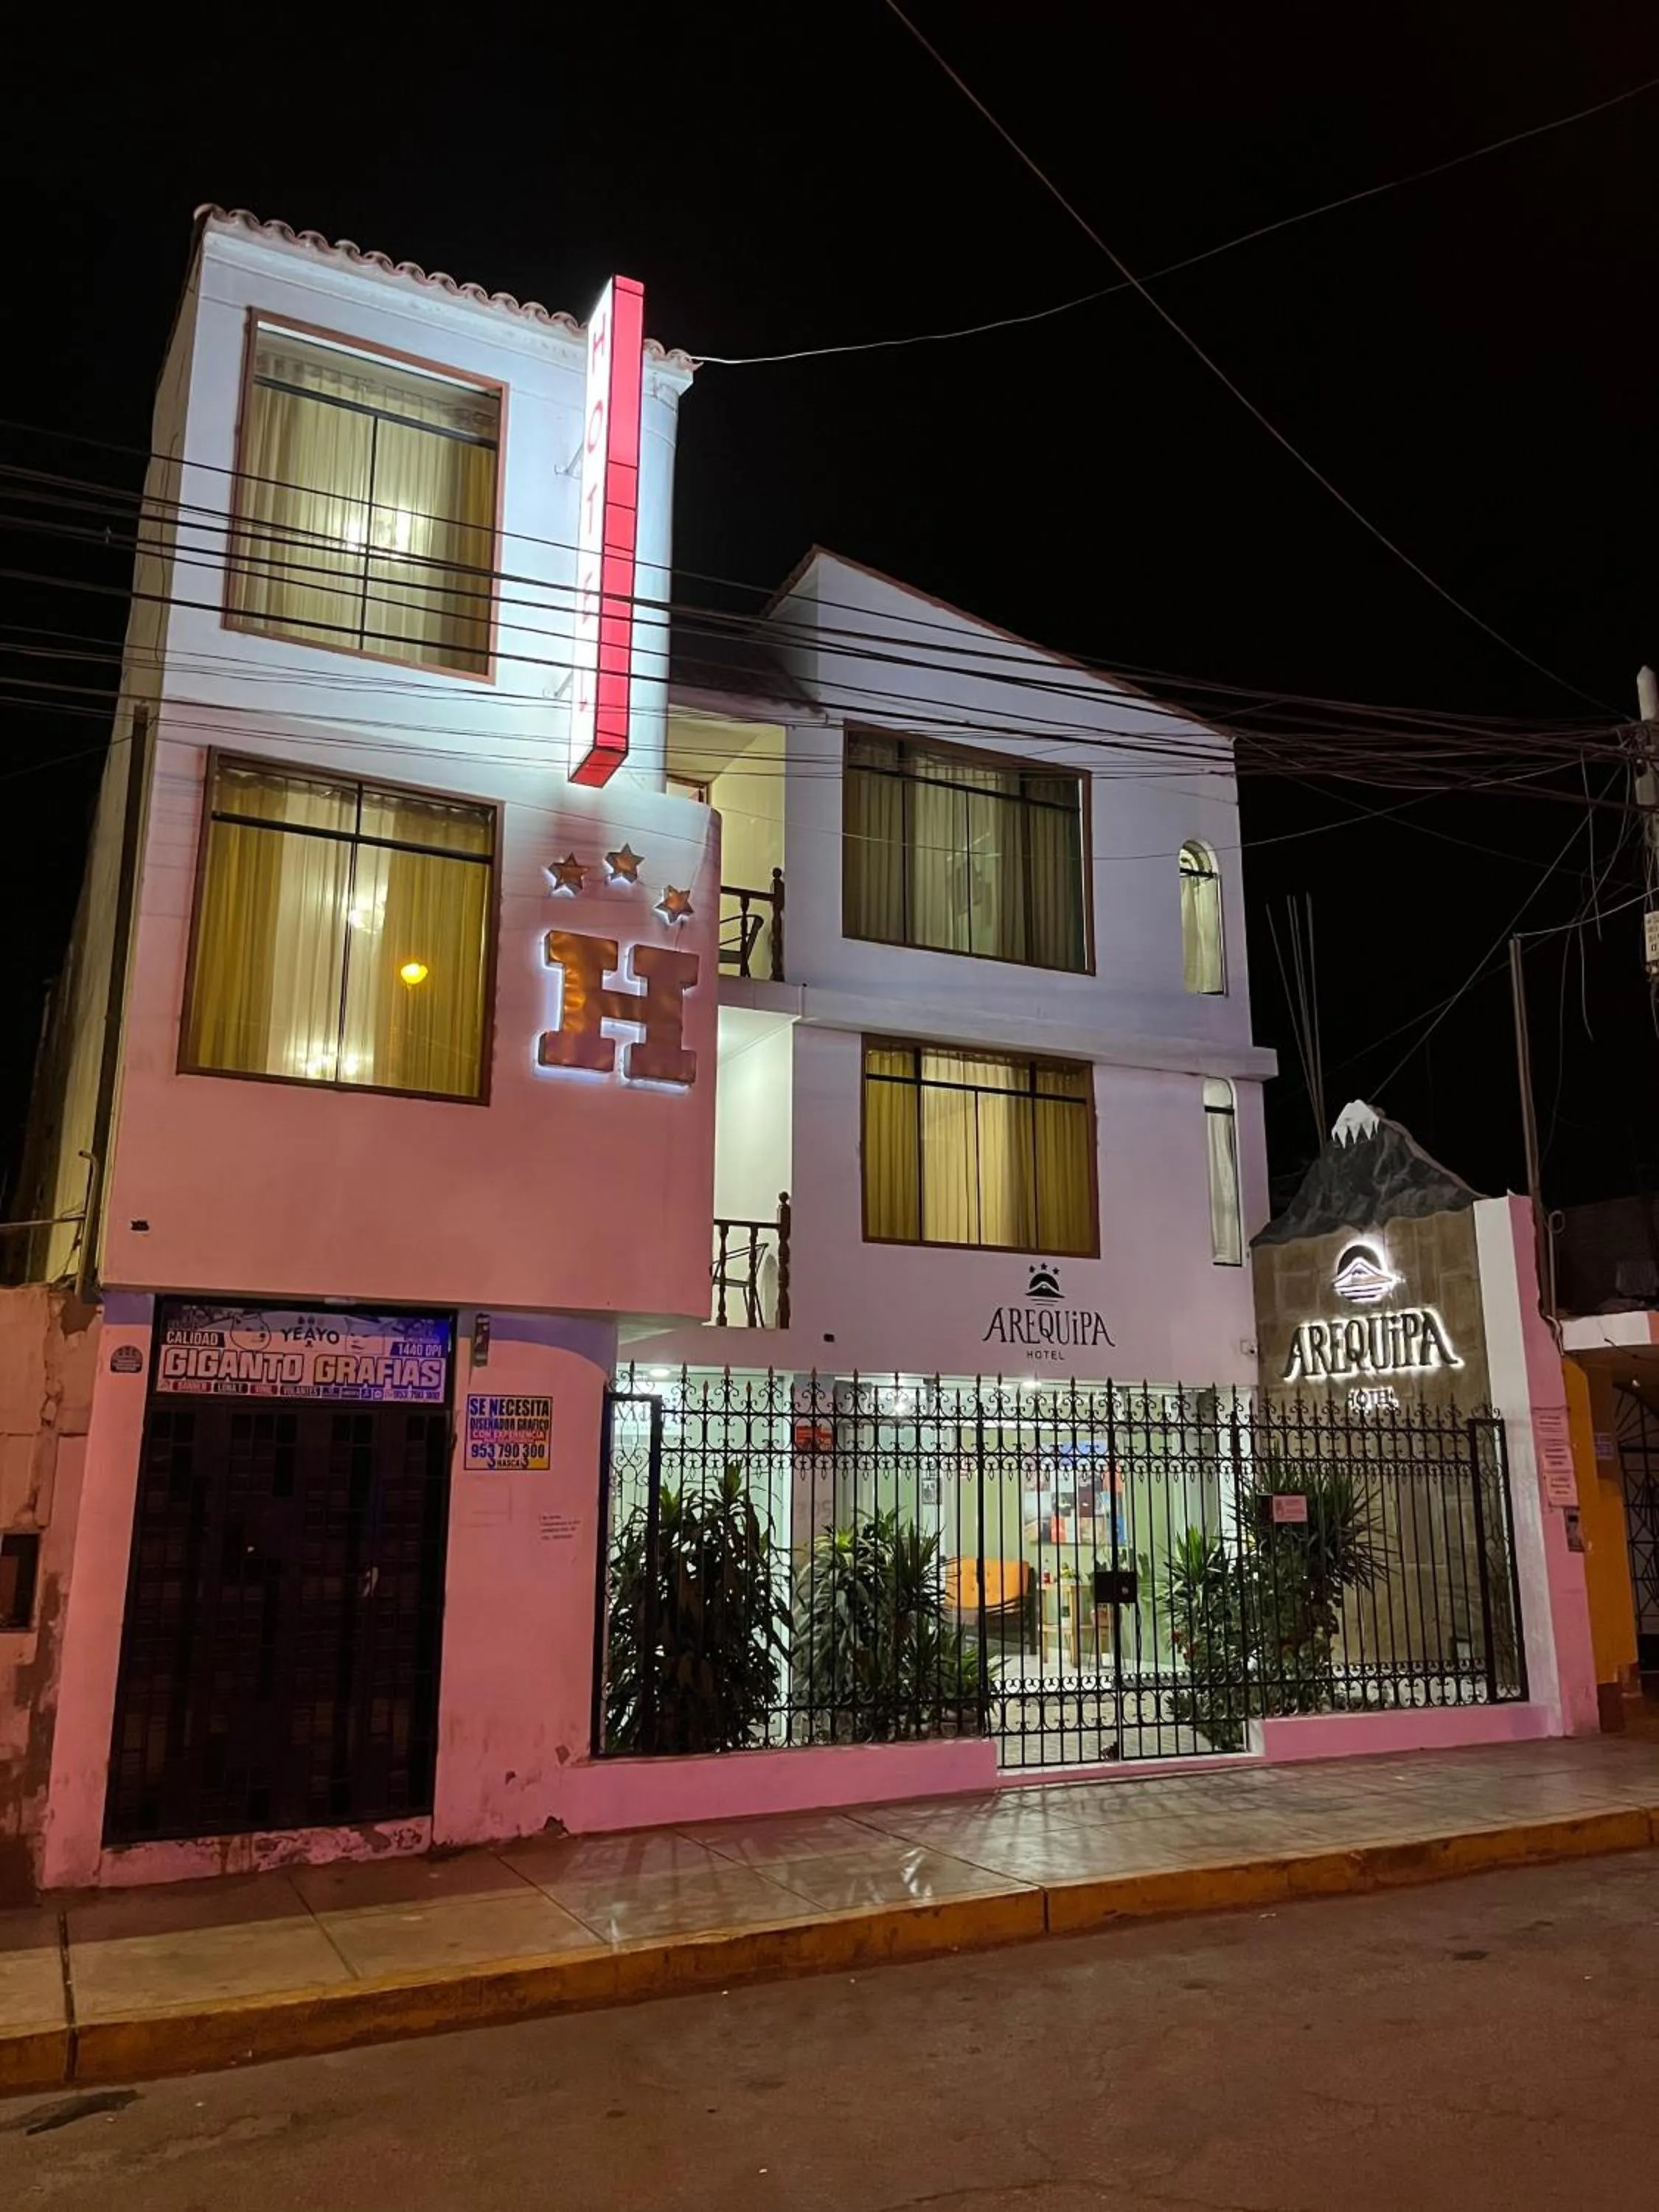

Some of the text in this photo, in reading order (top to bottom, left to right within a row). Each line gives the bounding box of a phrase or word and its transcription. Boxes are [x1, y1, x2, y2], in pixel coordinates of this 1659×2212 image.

[539, 929, 700, 1084] H
[166, 1331, 219, 1346] CALIDAD
[398, 1343, 422, 1356] 1440
[1026, 1350, 1064, 1360] HOTEL
[163, 1346, 304, 1383] GIGANTO
[314, 1354, 442, 1389] GRAFIAS
[470, 1397, 549, 1416] SE NECESITA
[471, 1443, 546, 1458] 953 790 300
